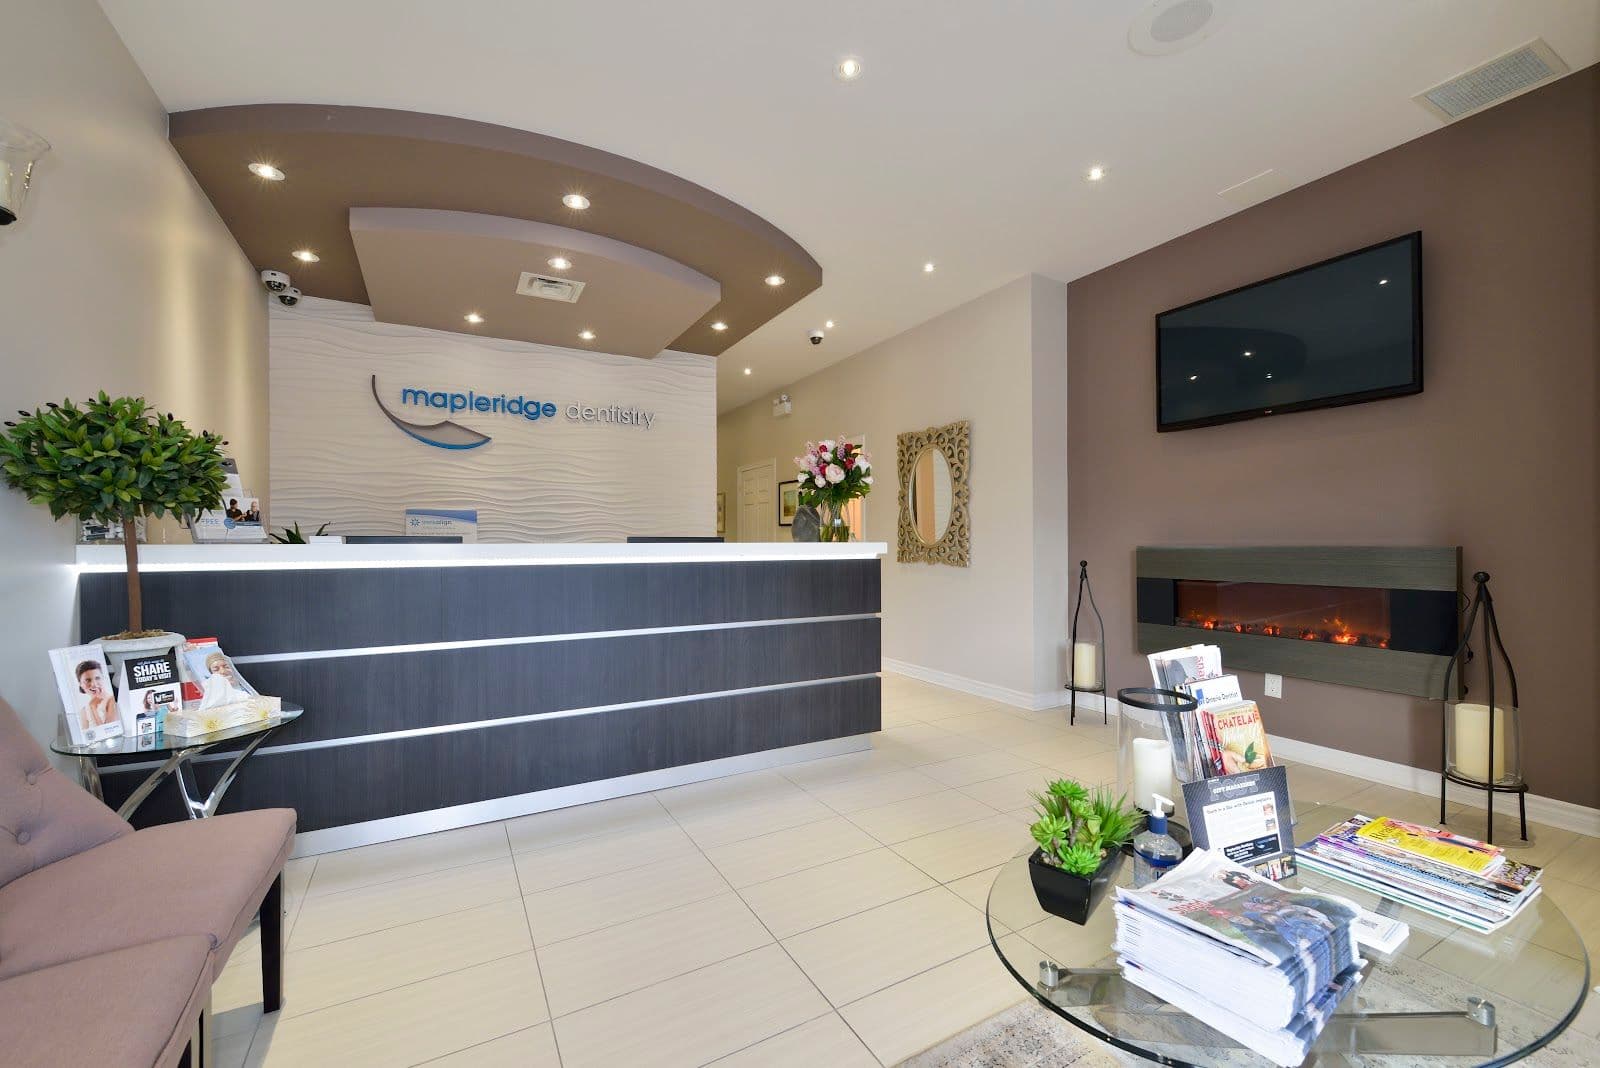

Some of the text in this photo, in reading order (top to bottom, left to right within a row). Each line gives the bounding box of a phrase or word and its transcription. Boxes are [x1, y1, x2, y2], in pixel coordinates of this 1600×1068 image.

[402, 388, 656, 430] mapleridge dentistry
[133, 661, 171, 677] SHARE
[158, 672, 171, 680] VISIT
